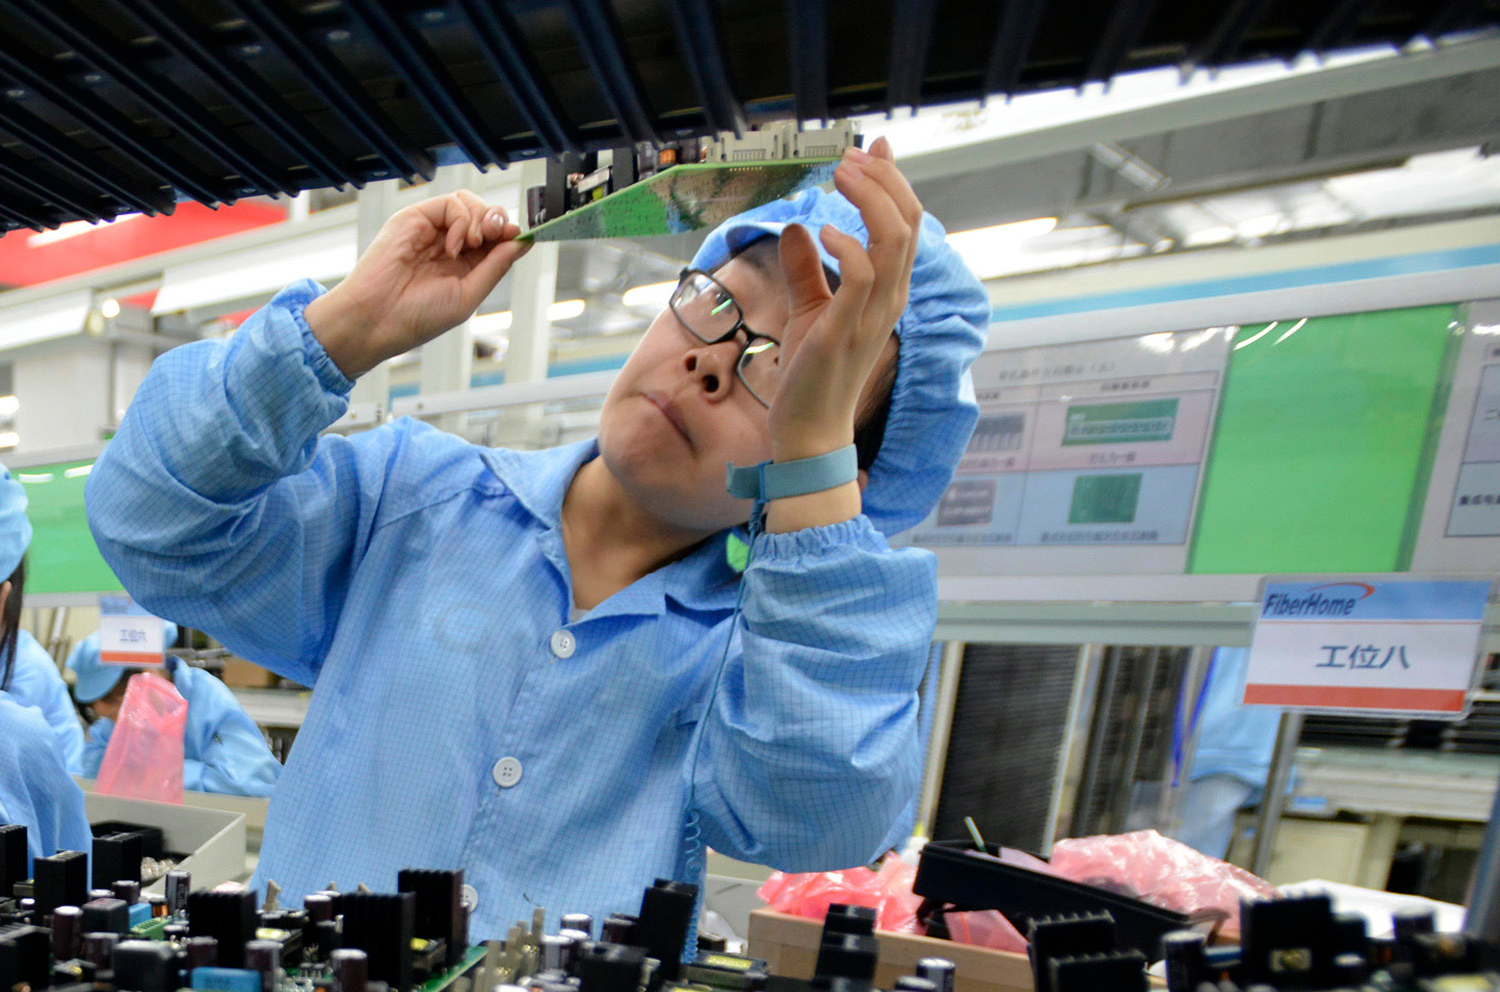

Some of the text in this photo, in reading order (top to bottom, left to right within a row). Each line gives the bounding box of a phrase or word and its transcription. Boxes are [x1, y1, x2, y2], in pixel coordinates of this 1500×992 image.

[1262, 593, 1356, 616] FiberHome
[1316, 645, 1411, 669] 工位八
